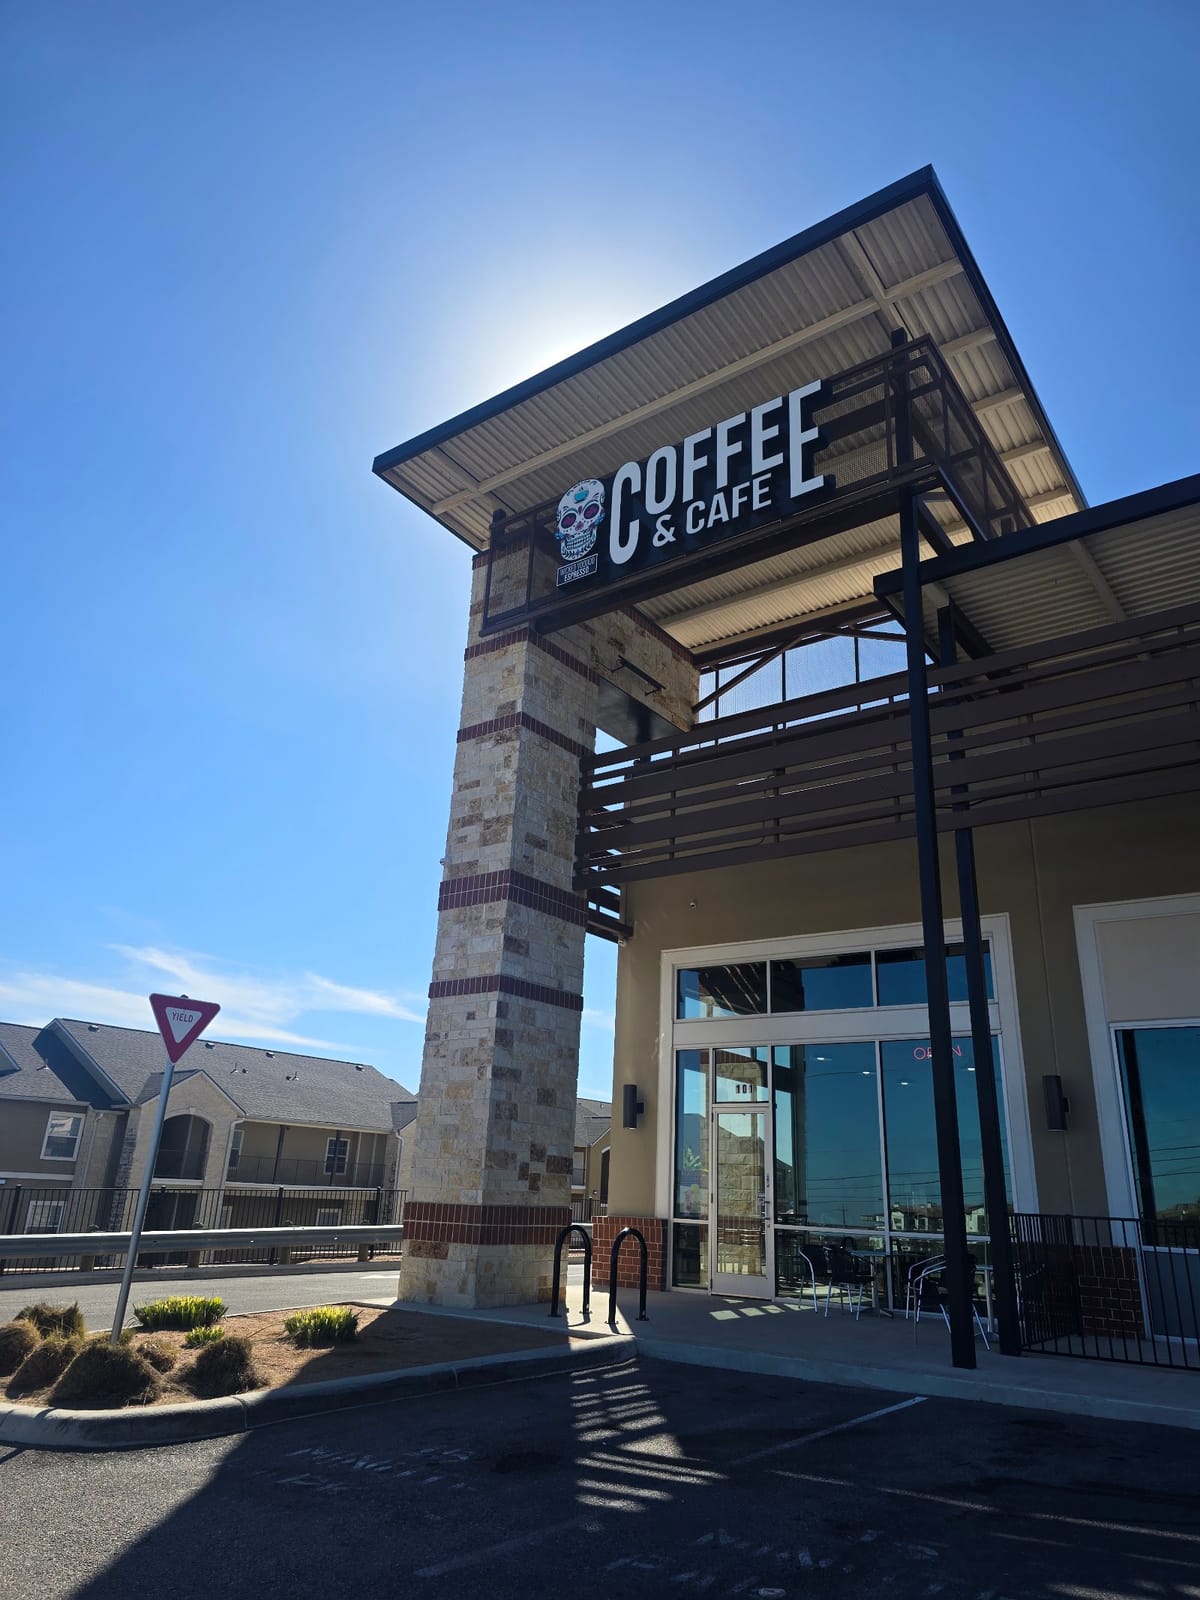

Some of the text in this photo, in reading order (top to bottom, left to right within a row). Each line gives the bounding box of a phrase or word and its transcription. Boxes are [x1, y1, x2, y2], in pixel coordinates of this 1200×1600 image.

[609, 379, 825, 565] COFFEE
[652, 473, 772, 547] & CAFE
[172, 1011, 194, 1023] YIELD
[913, 1044, 962, 1060] OPN
[736, 1084, 753, 1094] 101
